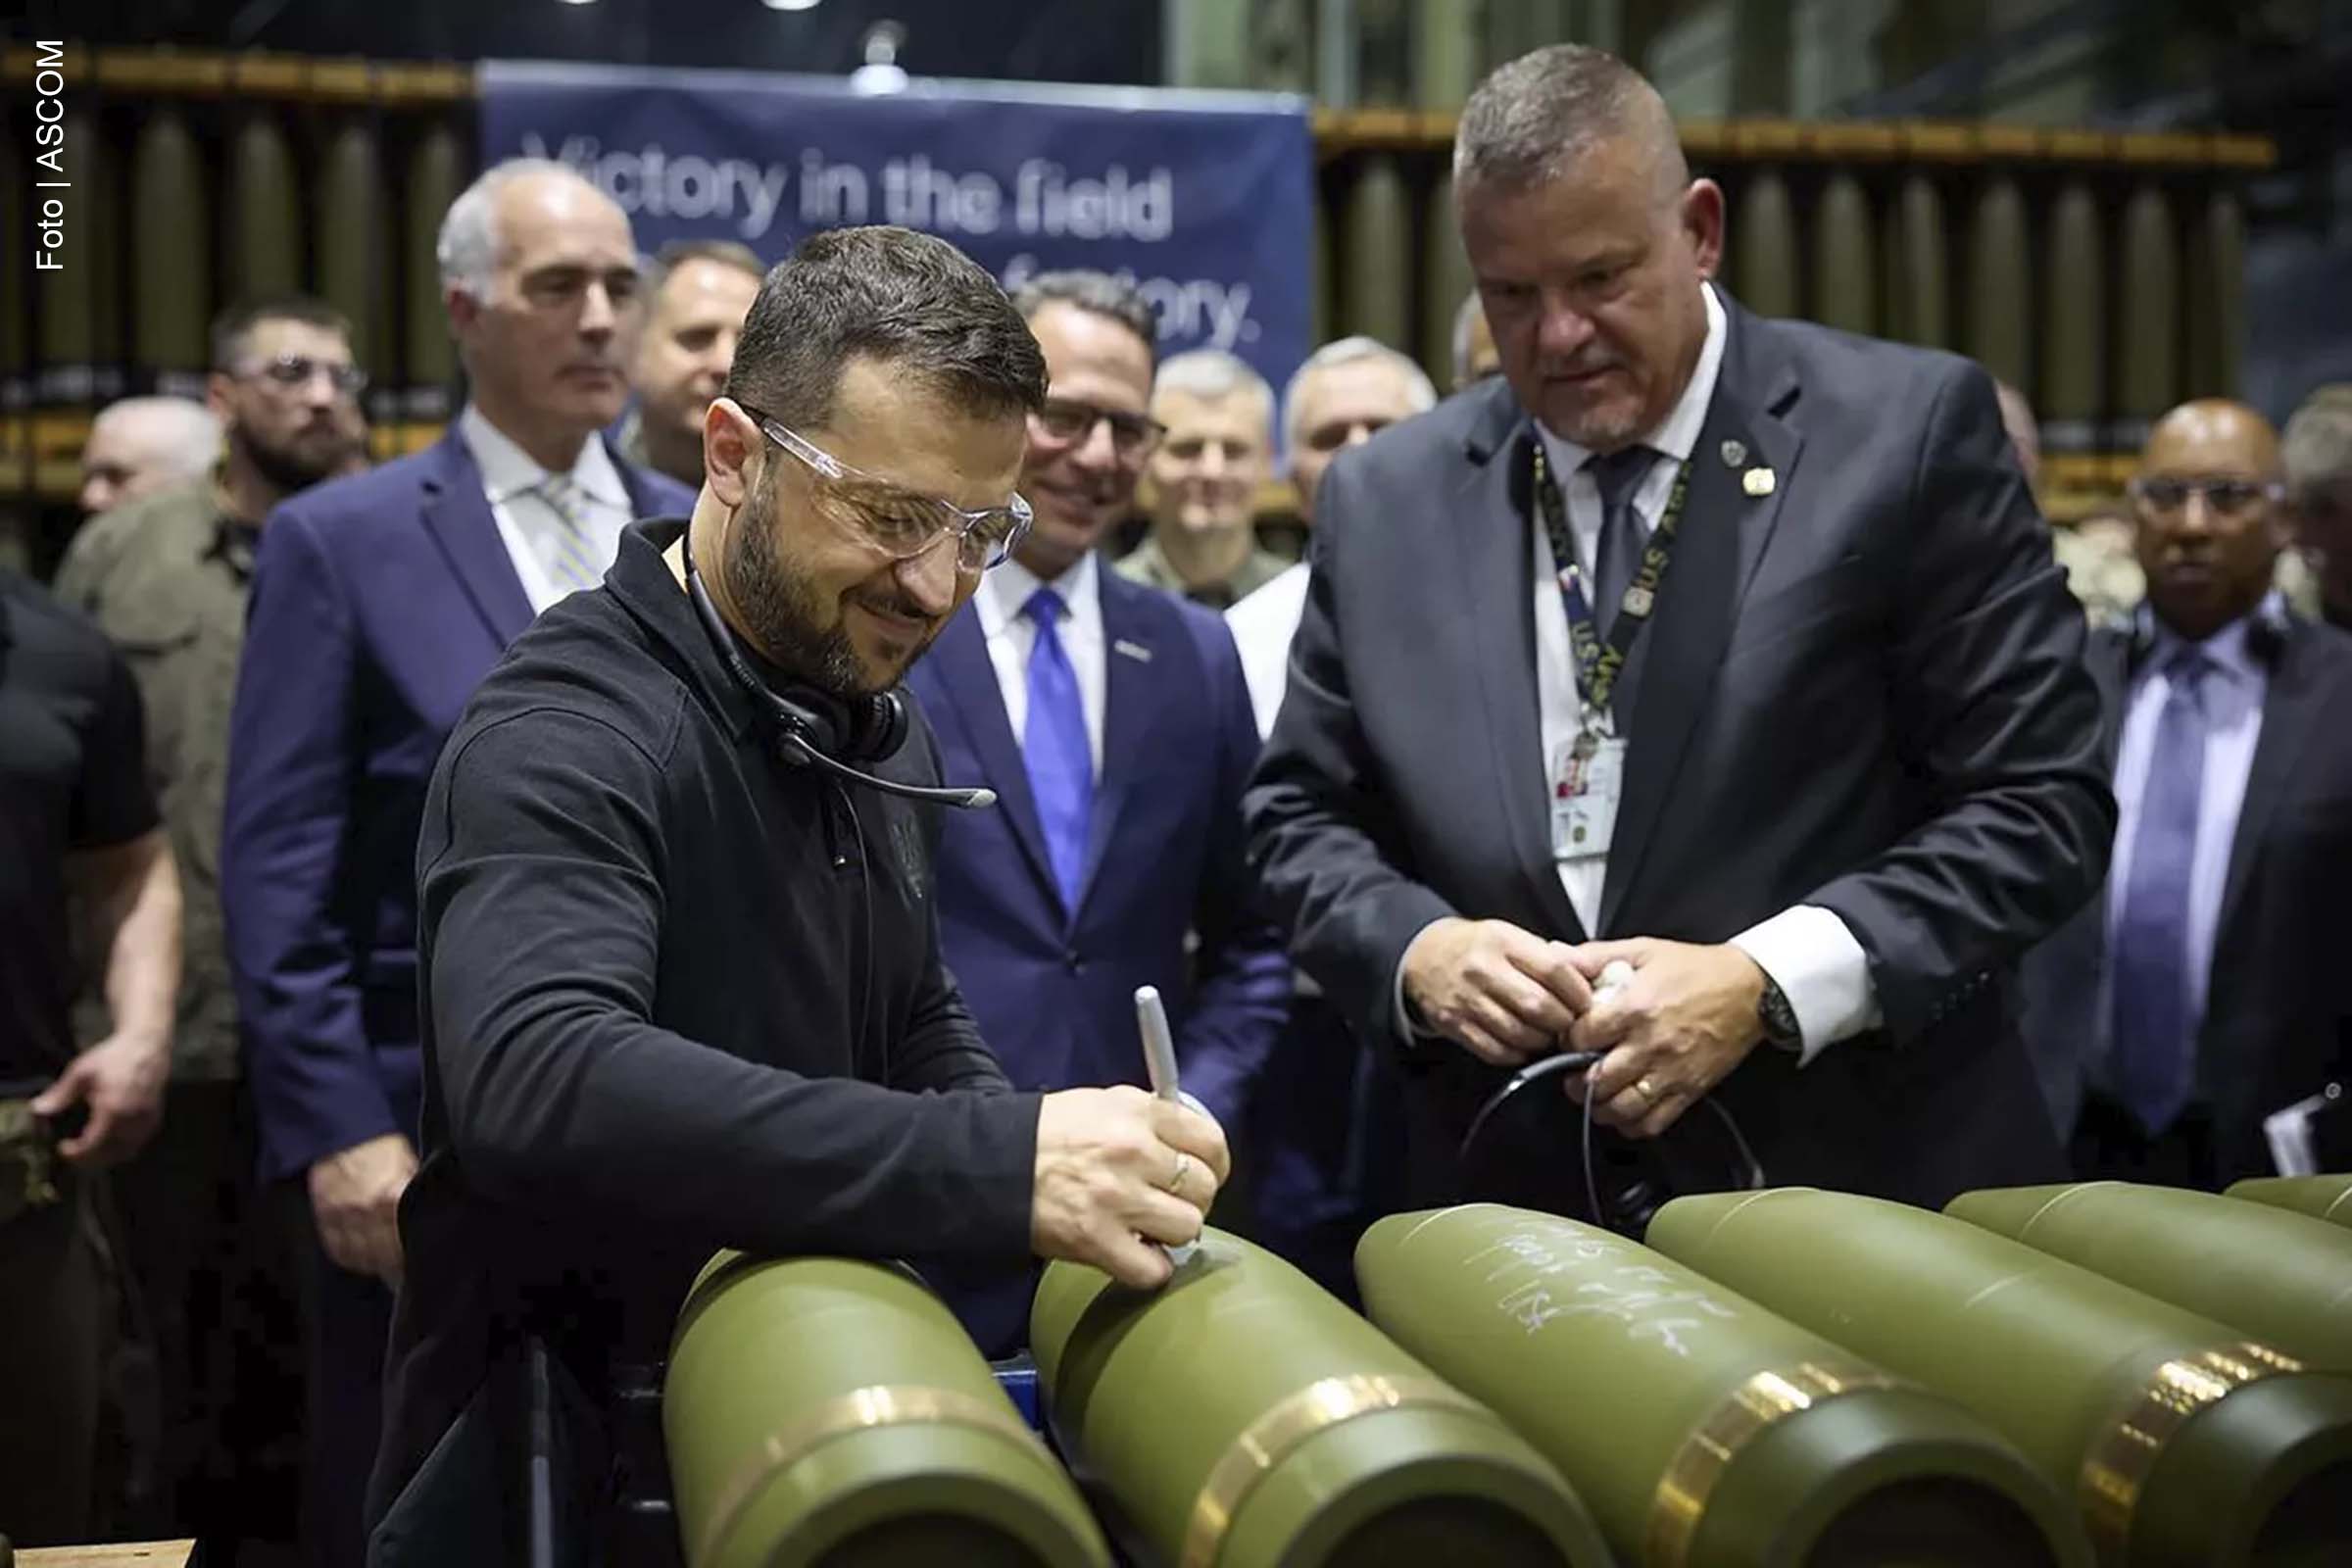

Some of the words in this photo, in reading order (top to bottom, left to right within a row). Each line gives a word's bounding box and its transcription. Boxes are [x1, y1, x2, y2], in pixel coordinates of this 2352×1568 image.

[800, 147, 868, 226] in
[884, 152, 1002, 235] the
[1015, 158, 1174, 243] field
